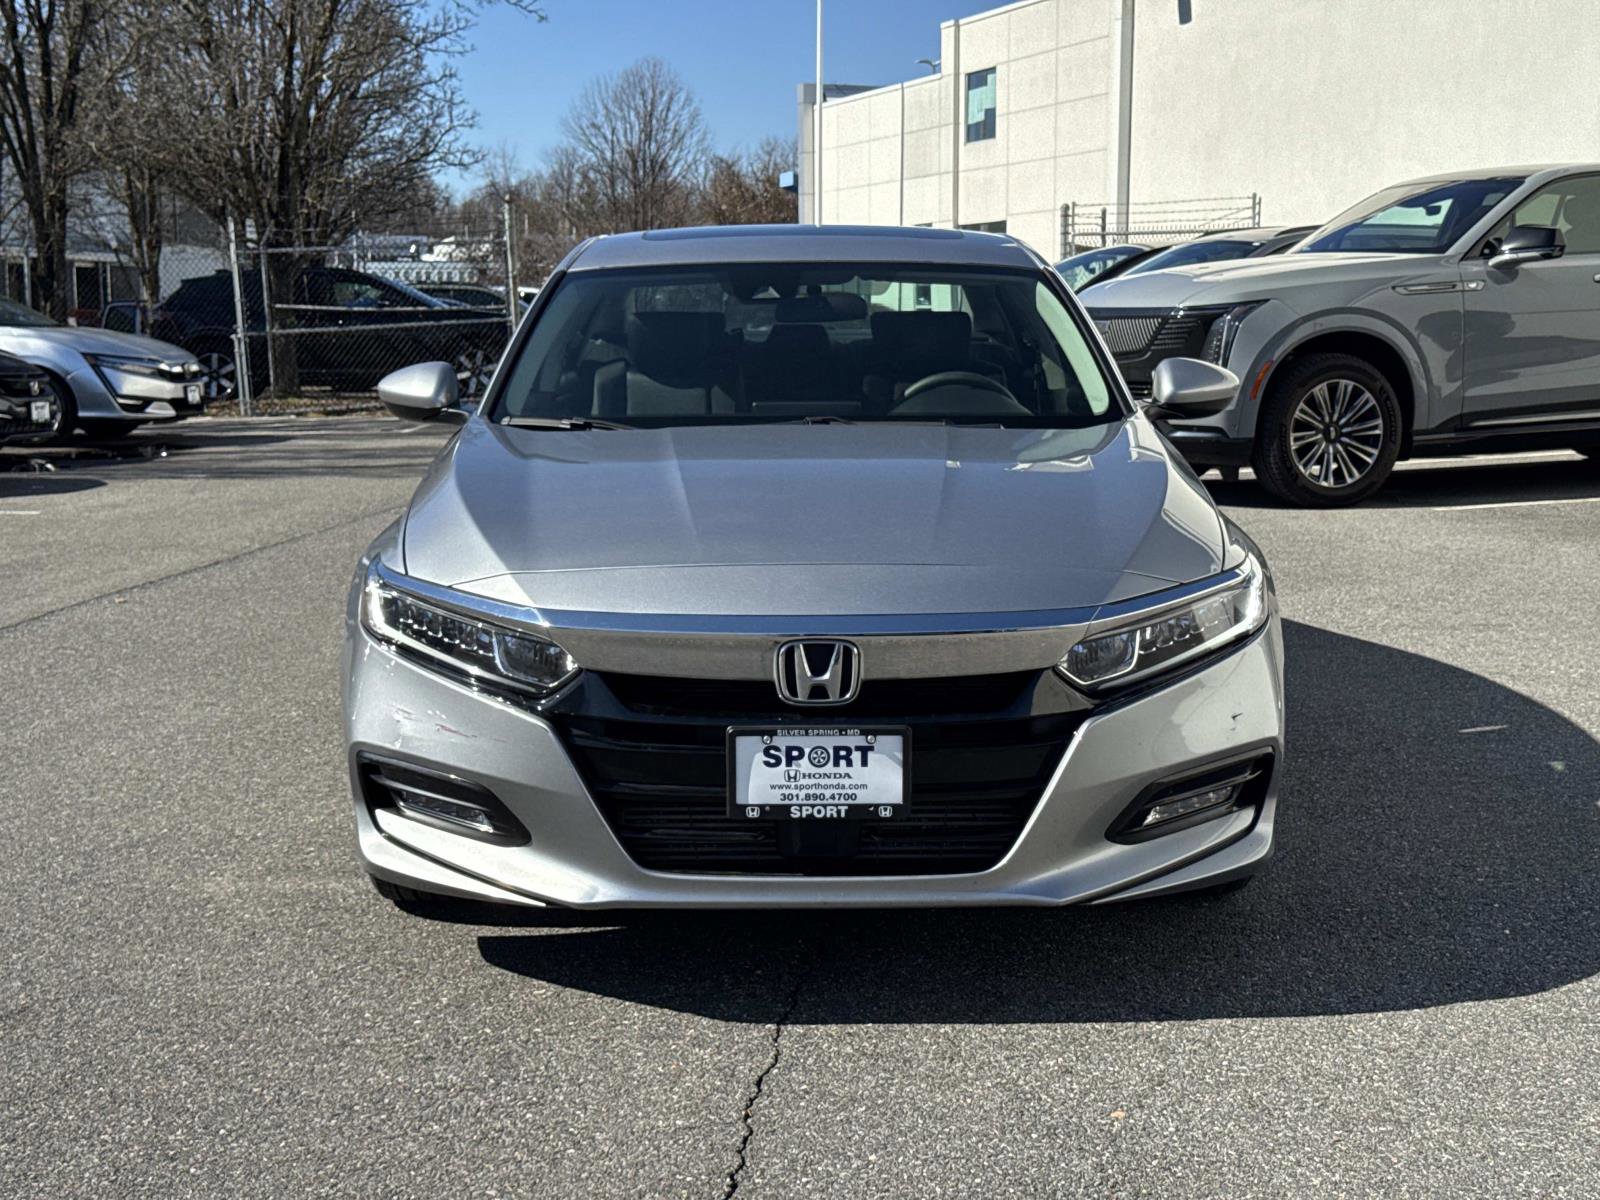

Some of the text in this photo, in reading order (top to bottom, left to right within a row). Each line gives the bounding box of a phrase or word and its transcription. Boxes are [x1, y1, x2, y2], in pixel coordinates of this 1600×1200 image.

[762, 745, 875, 768] SPORT
[769, 782, 868, 792] www.sporthonda.com
[780, 793, 857, 801] 301.890.4700
[790, 805, 849, 818] SPORT
